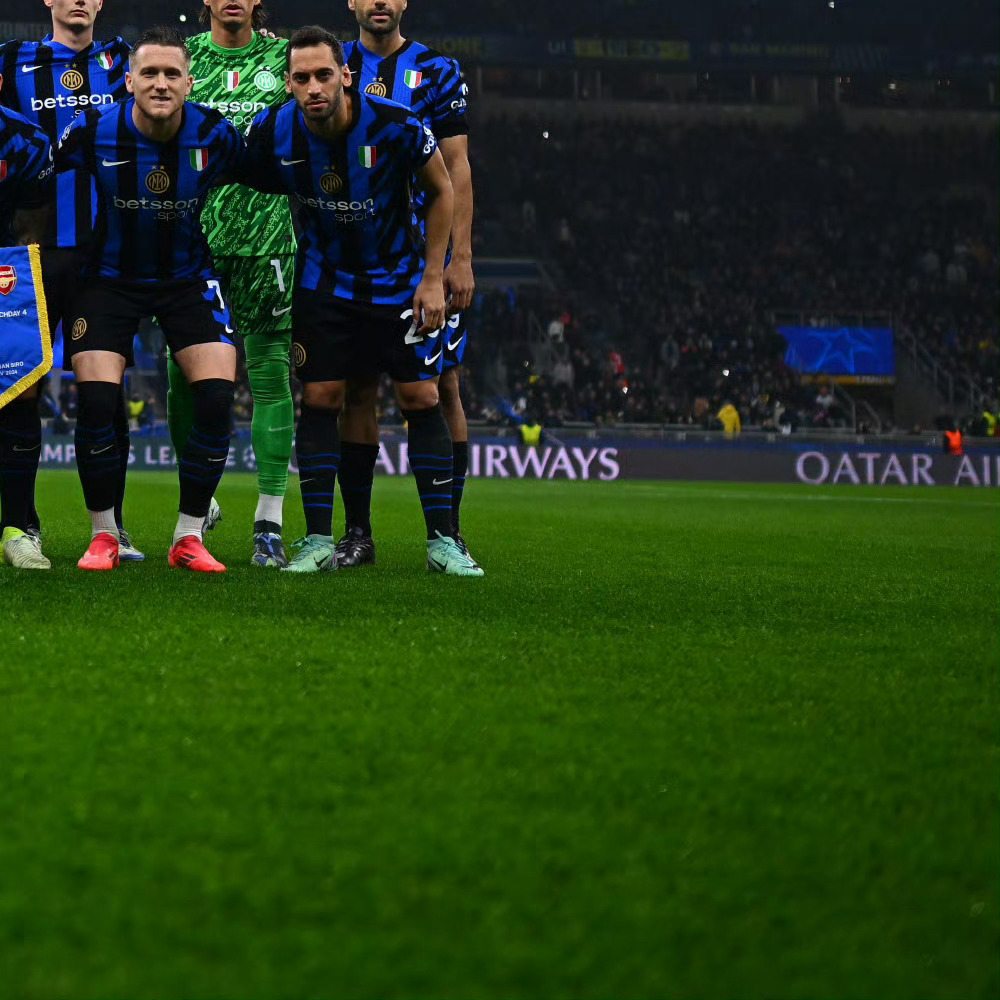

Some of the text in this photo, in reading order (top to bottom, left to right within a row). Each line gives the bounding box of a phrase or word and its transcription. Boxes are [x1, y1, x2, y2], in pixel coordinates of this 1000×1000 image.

[31, 93, 113, 112] betsson
[113, 196, 199, 210] betsson
[294, 191, 374, 211] betsson
[270, 259, 286, 292] 1
[466, 444, 620, 481] IRWAYS
